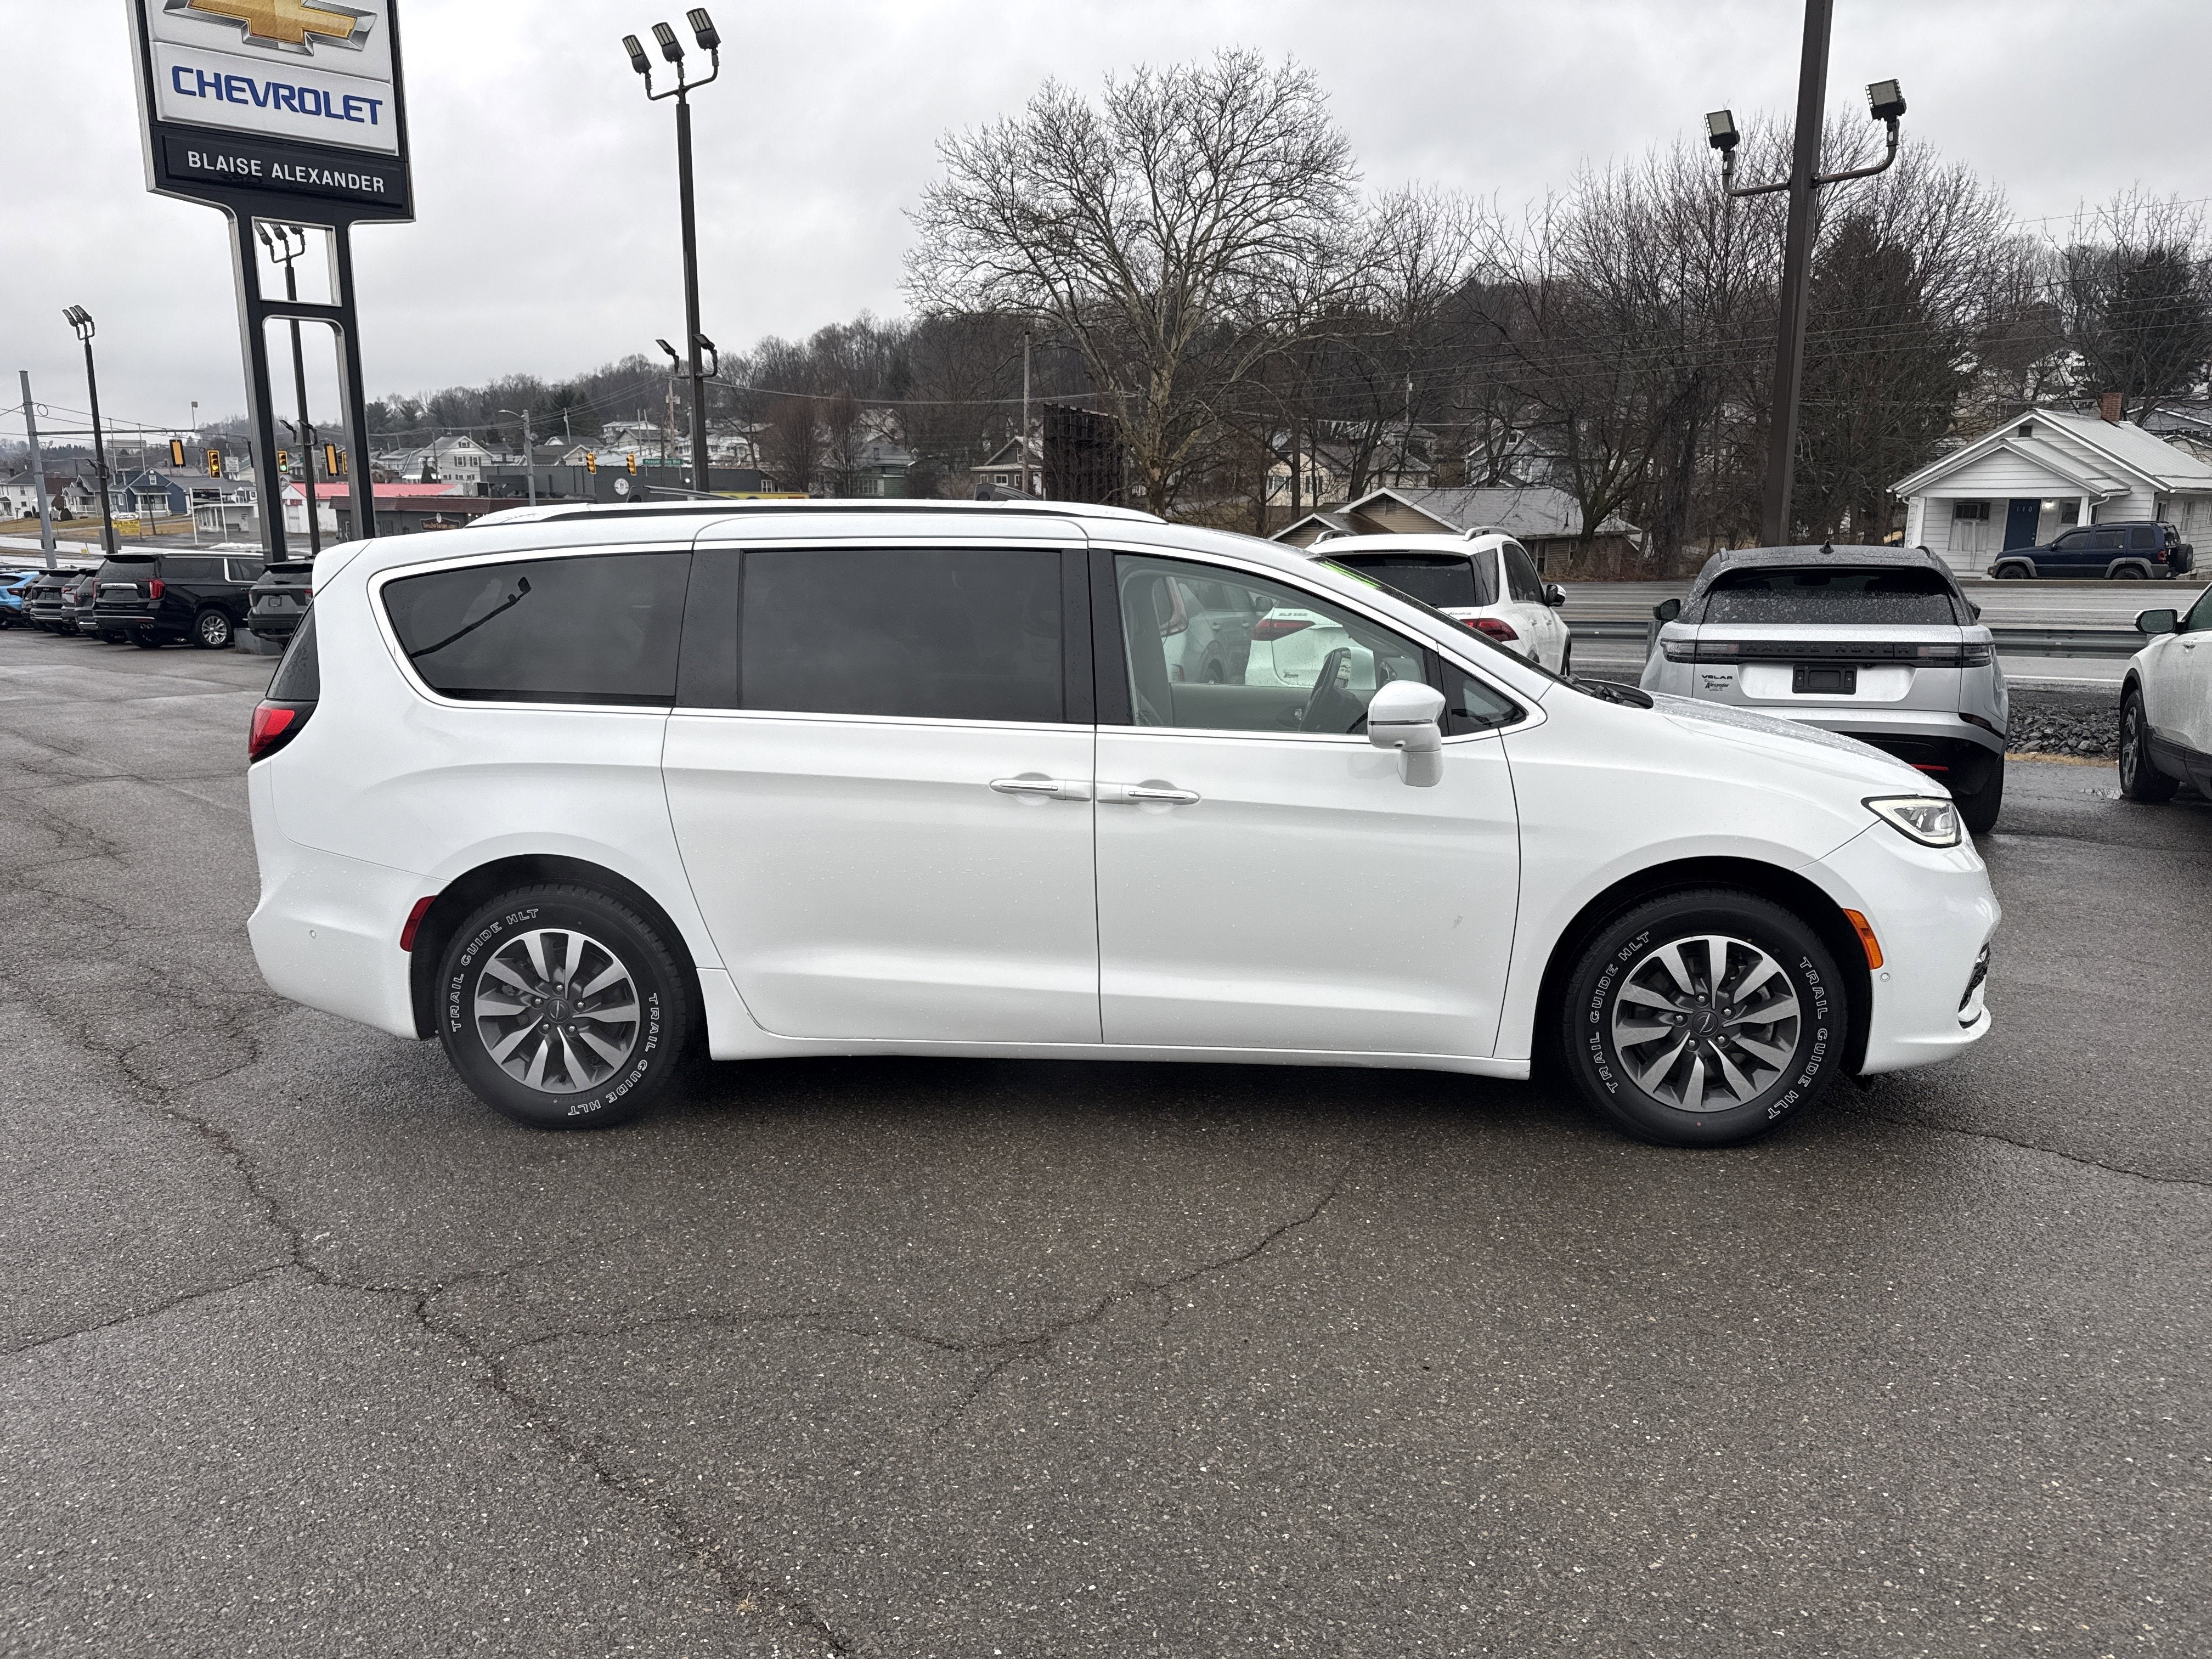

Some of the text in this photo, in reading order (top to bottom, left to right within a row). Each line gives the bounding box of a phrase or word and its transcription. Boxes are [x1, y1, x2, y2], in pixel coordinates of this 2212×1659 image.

[172, 65, 383, 125] CHEVROLET
[187, 151, 385, 193] BLAISE ALEXANDER
[1746, 645, 1910, 654] RANGE ROVER
[450, 909, 539, 1032] TRAIL GUIDE HLT
[645, 992, 659, 1052] TRAIL
[1589, 931, 1650, 1094] TRAIL GUIDE HLT
[1768, 956, 1829, 1120] TRAIL GUIDE HLT
[567, 1099, 601, 1116] HLT
[605, 1059, 648, 1104] GUIDE
